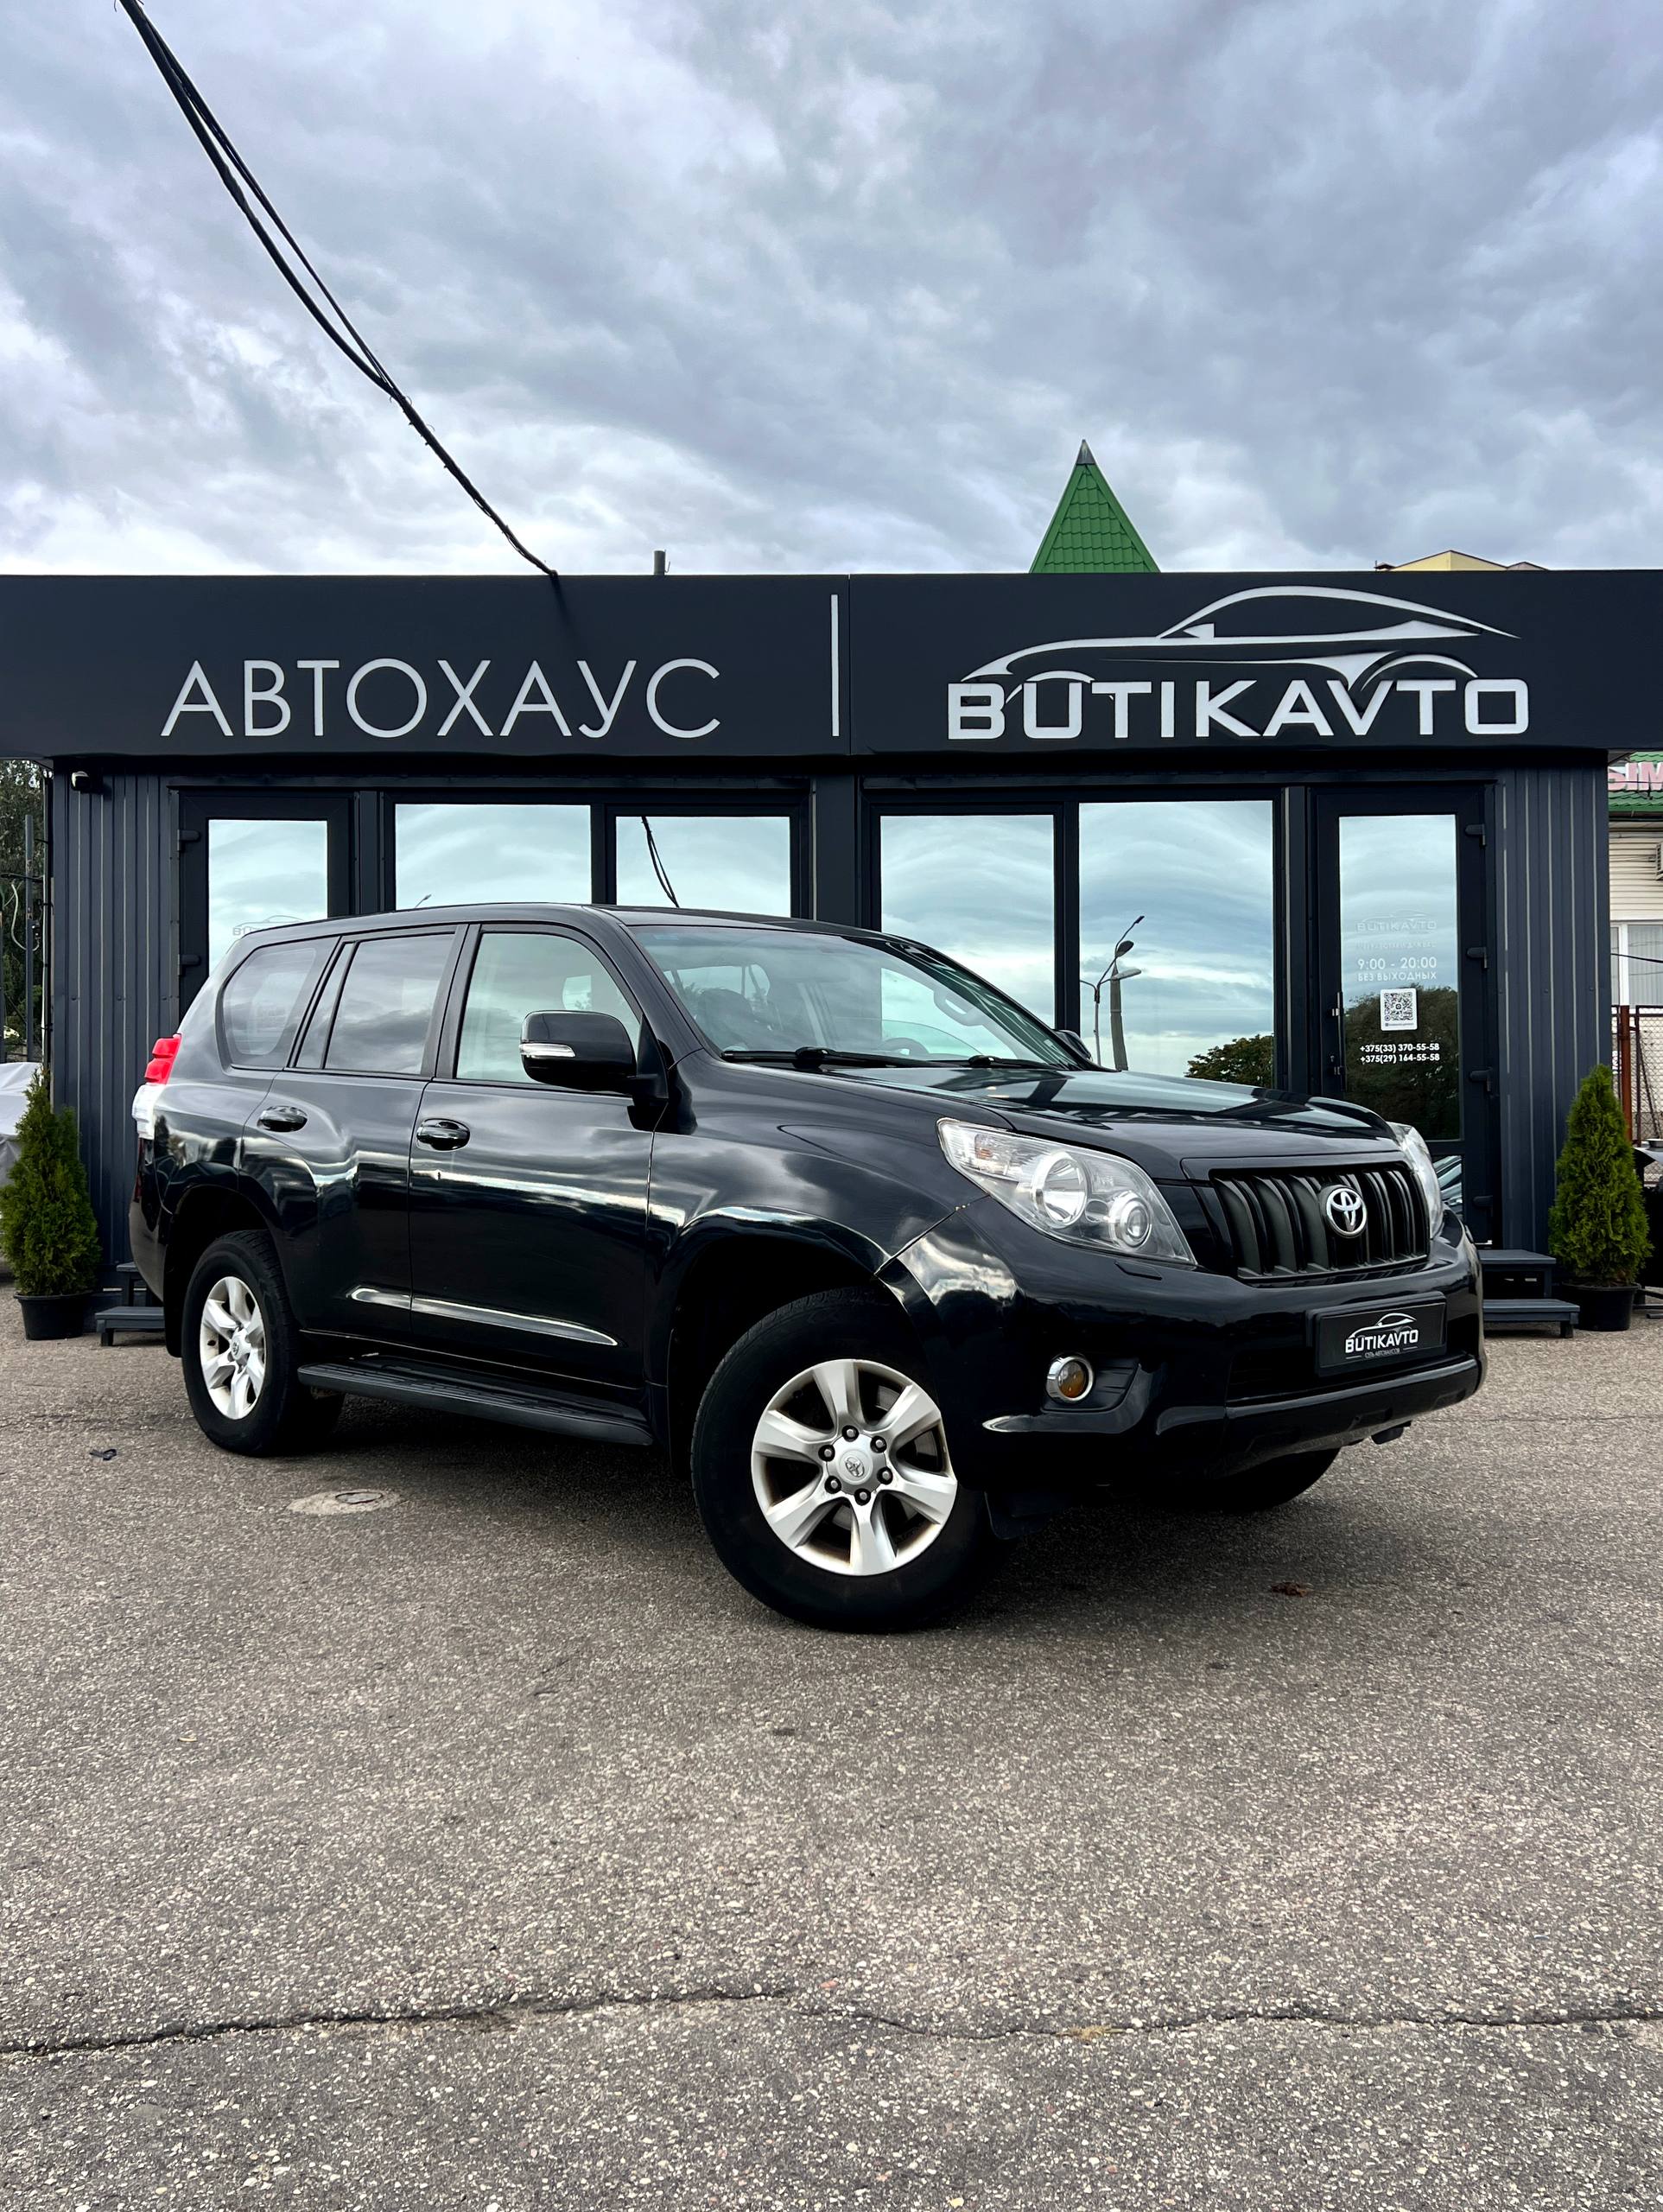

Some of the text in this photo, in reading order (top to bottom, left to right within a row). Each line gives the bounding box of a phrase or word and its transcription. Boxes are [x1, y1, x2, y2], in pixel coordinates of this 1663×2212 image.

[161, 658, 721, 738] АВТОХАУС
[948, 678, 1529, 740] BUTIKAVTO
[1356, 920, 1437, 931] BUTIKAVTO
[1357, 957, 1386, 969] 9:00
[1400, 957, 1437, 969] 20:00
[1357, 971, 1437, 982] БЕЗ ВЫХОДНЫХ
[1360, 1043, 1440, 1053] +375(33) 370-55-58
[1360, 1053, 1440, 1064] +375(29) 164-55-58
[1345, 1329, 1419, 1353] BUTIKAVTO
